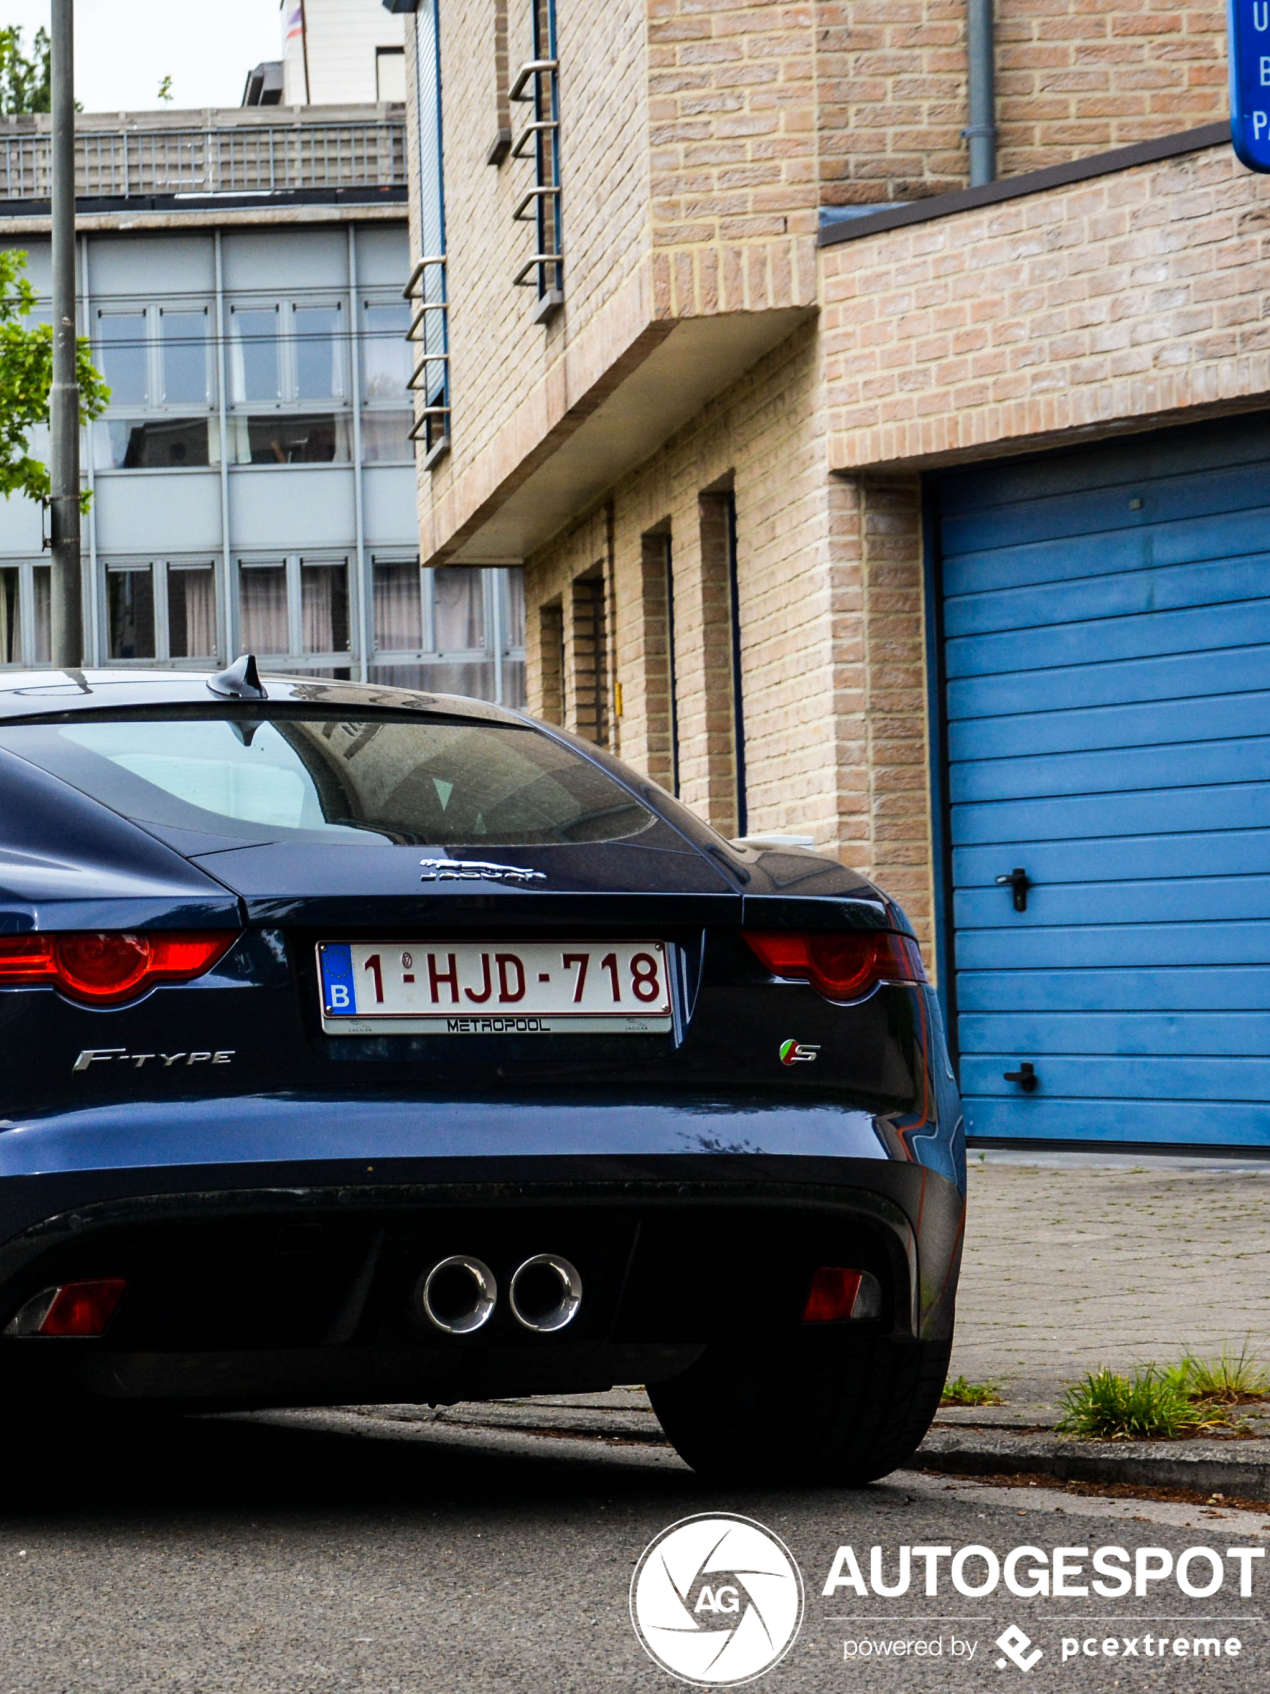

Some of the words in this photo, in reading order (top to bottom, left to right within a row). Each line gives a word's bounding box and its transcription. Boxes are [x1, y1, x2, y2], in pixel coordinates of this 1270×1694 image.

[1253, 111, 1270, 141] P
[364, 952, 661, 1004] 1-HJD-718
[331, 984, 350, 1007] B
[446, 1018, 551, 1032] METROPOOL
[73, 1048, 236, 1070] F-TYPE
[790, 1044, 822, 1061] S
